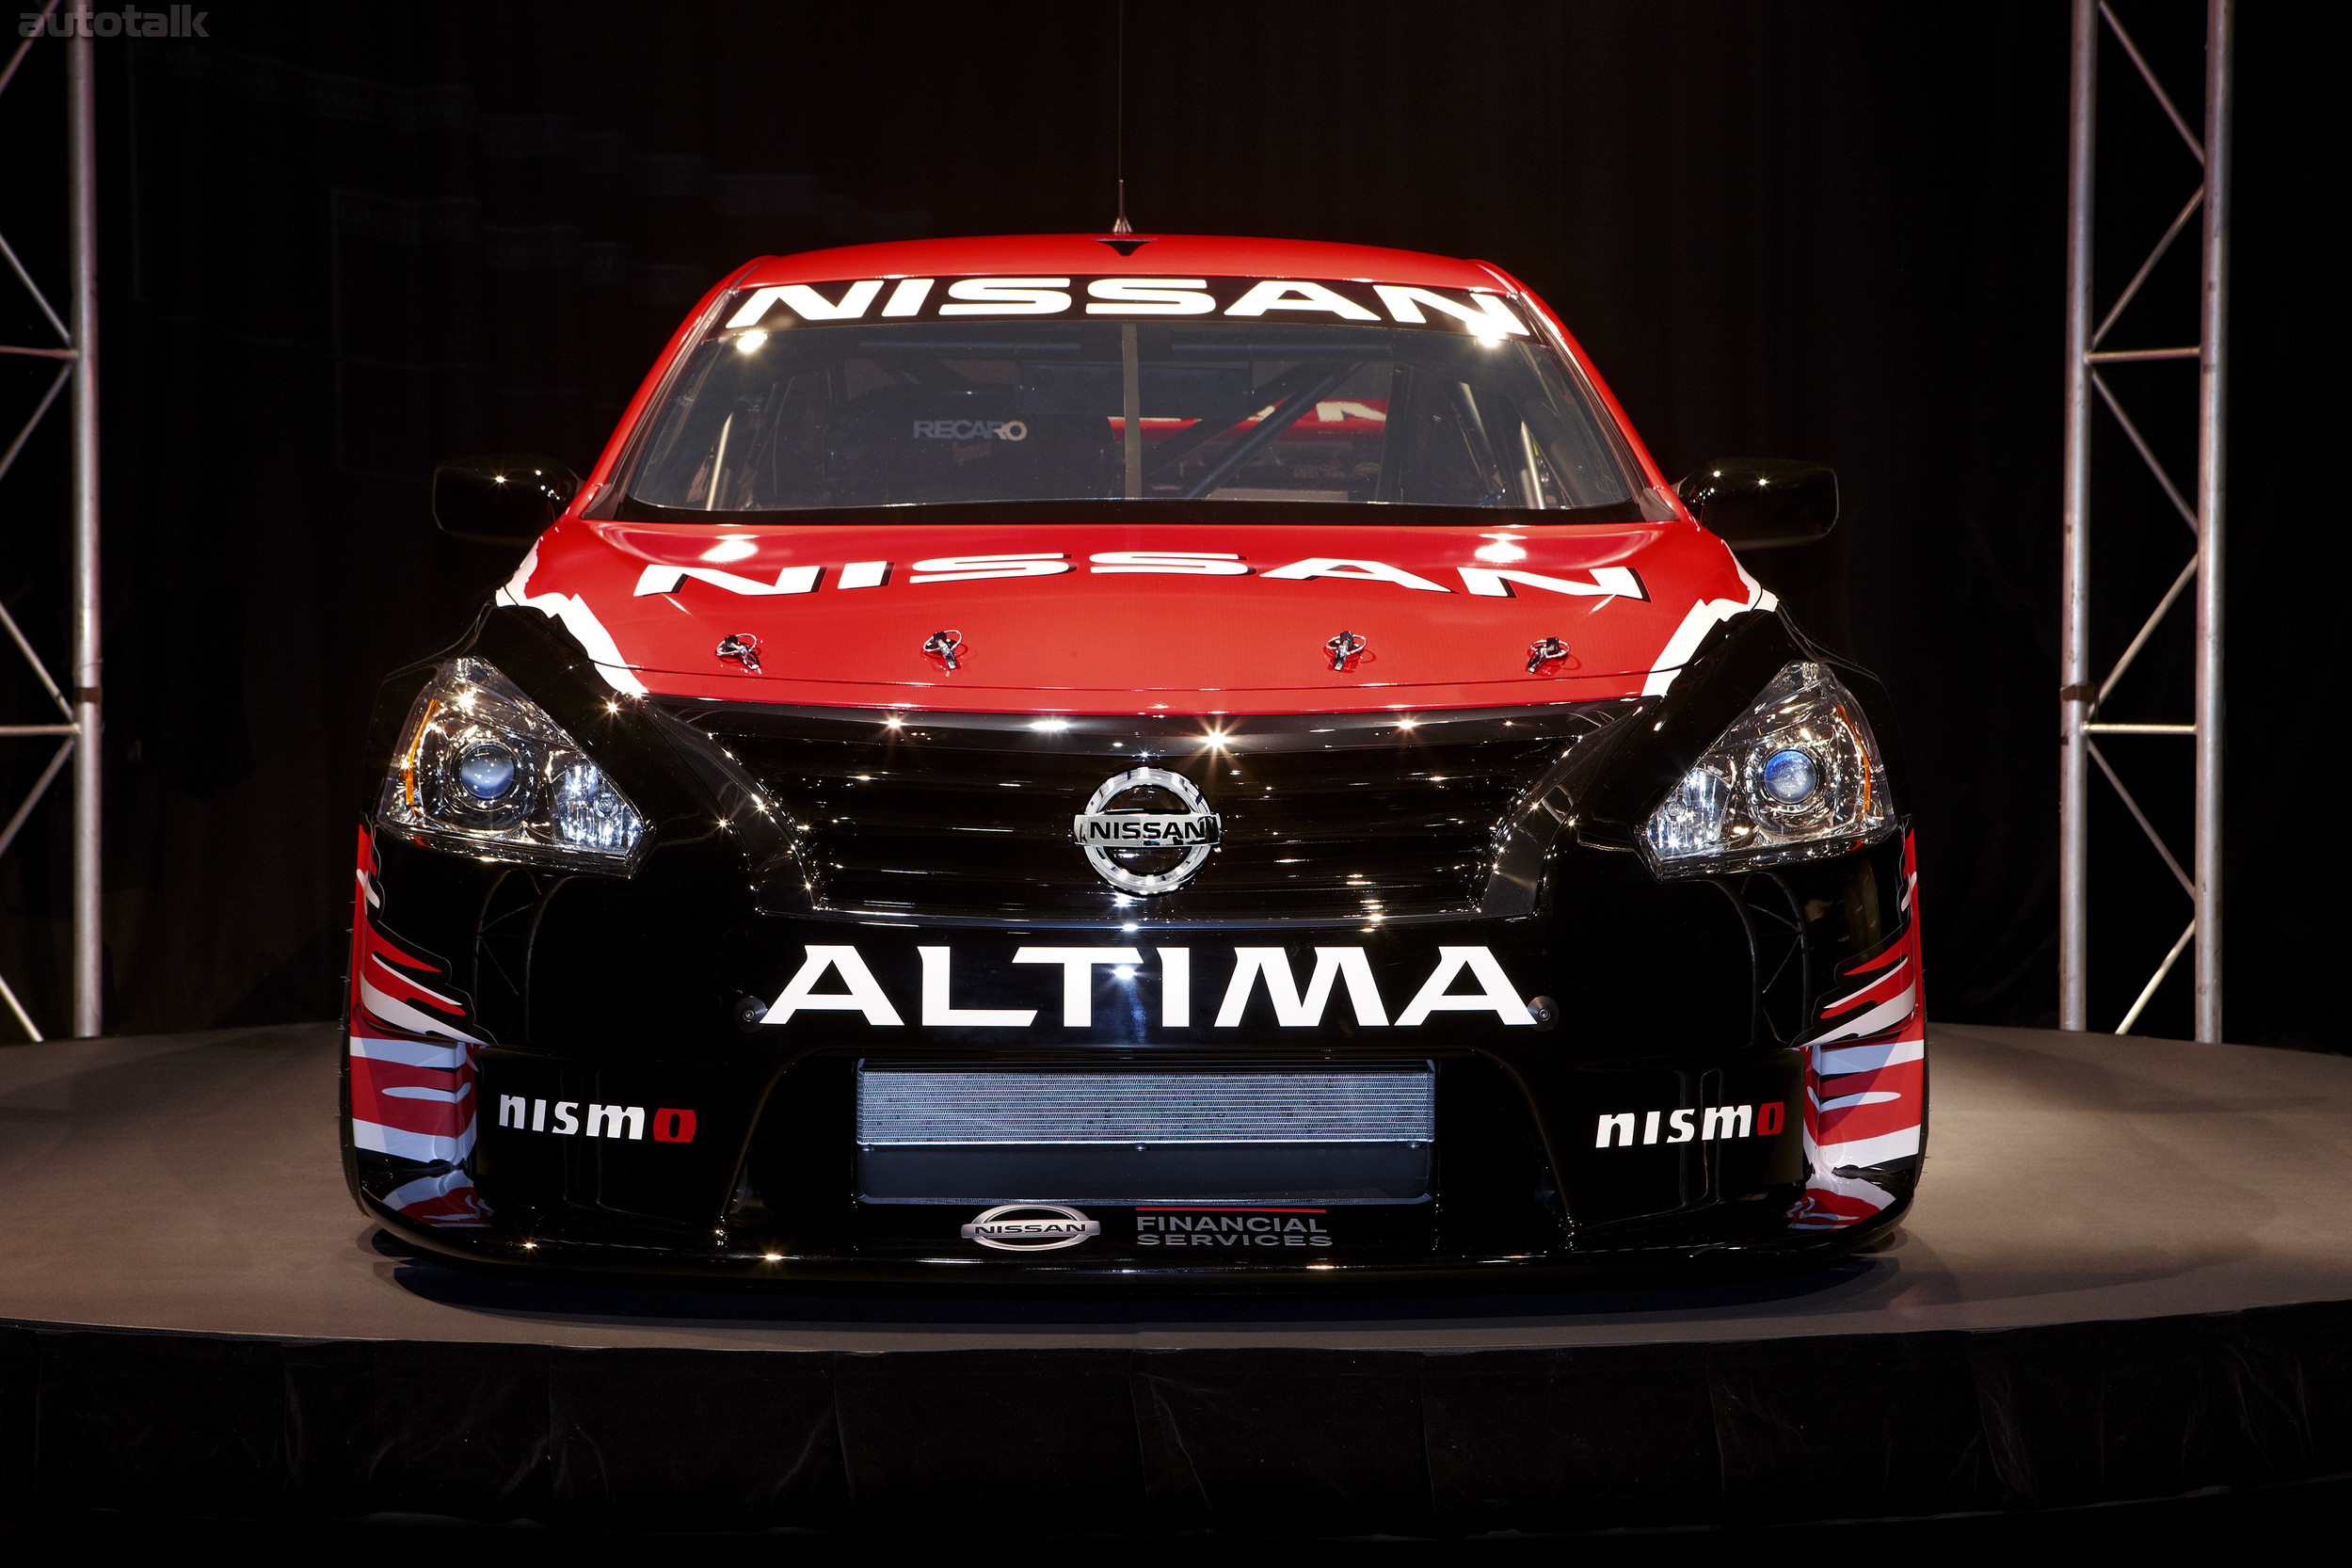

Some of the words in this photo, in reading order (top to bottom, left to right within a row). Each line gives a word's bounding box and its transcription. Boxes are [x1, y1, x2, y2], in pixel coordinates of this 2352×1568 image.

[725, 277, 1530, 337] NISSAN
[913, 420, 1028, 441] RECARO
[633, 552, 1652, 602] NISSAN
[1090, 822, 1206, 840] NISSAN
[759, 944, 1539, 1028] ALTIMA
[499, 1094, 696, 1144] nismo
[1595, 1100, 1785, 1148] nismo
[974, 1223, 1088, 1235] NISSAN
[1136, 1234, 1334, 1247] SERVICES
[1137, 1216, 1328, 1234] FINANCIAL
